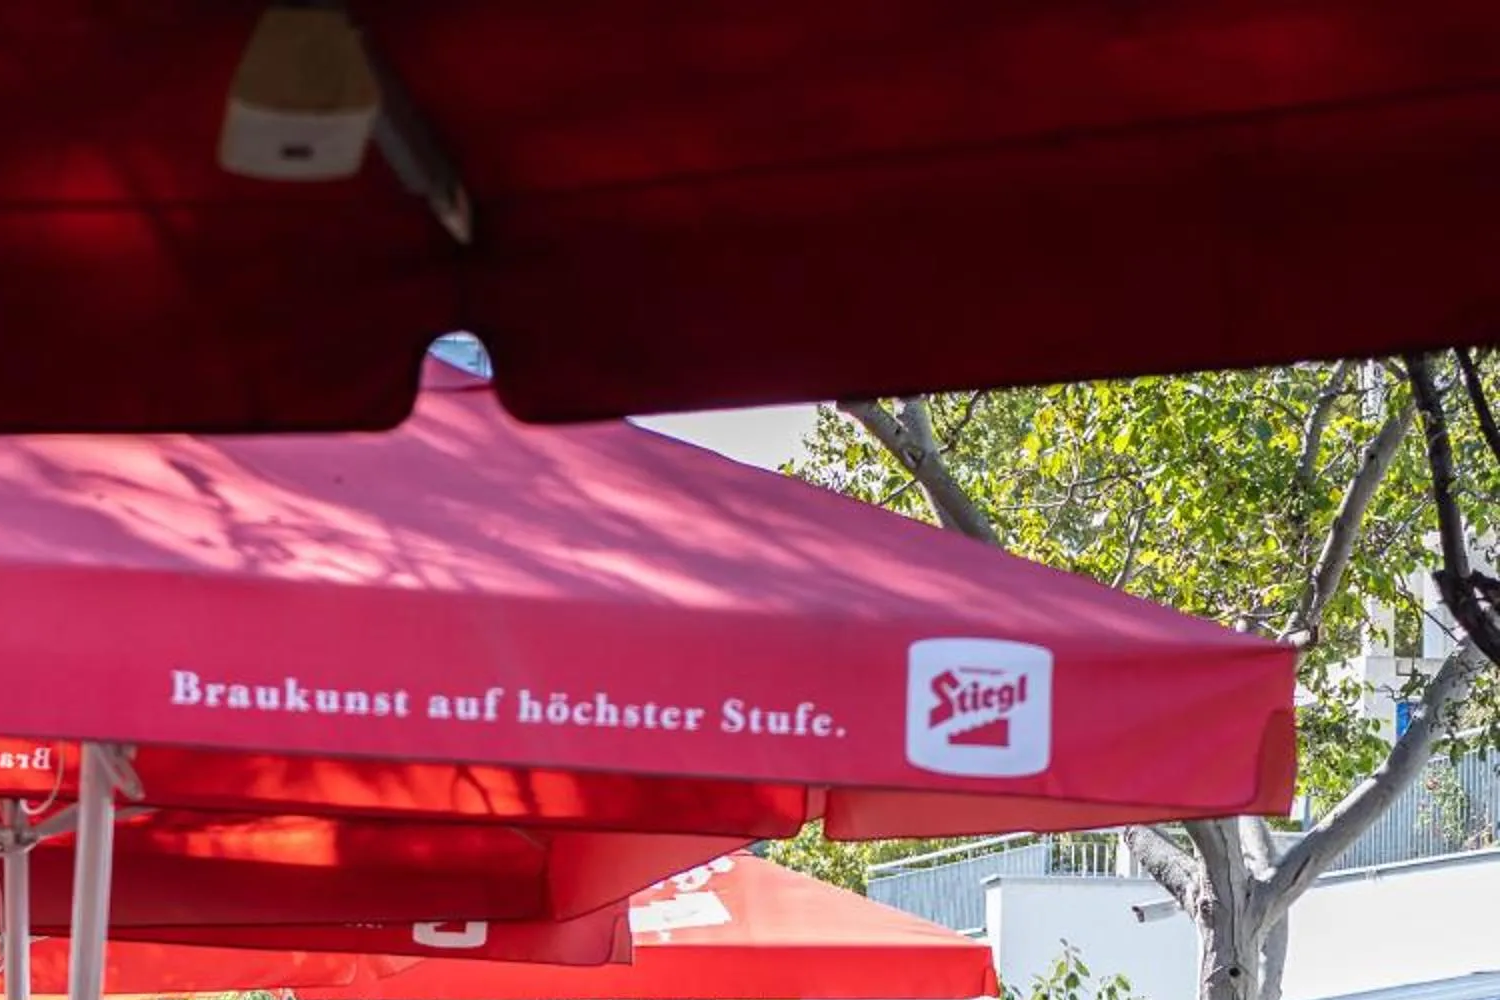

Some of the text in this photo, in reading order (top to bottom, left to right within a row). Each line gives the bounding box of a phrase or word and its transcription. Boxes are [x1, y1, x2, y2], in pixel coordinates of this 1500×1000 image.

[170, 669, 847, 738] Braukunst auf höchster Stufe.
[927, 668, 1028, 730] Stiegl
